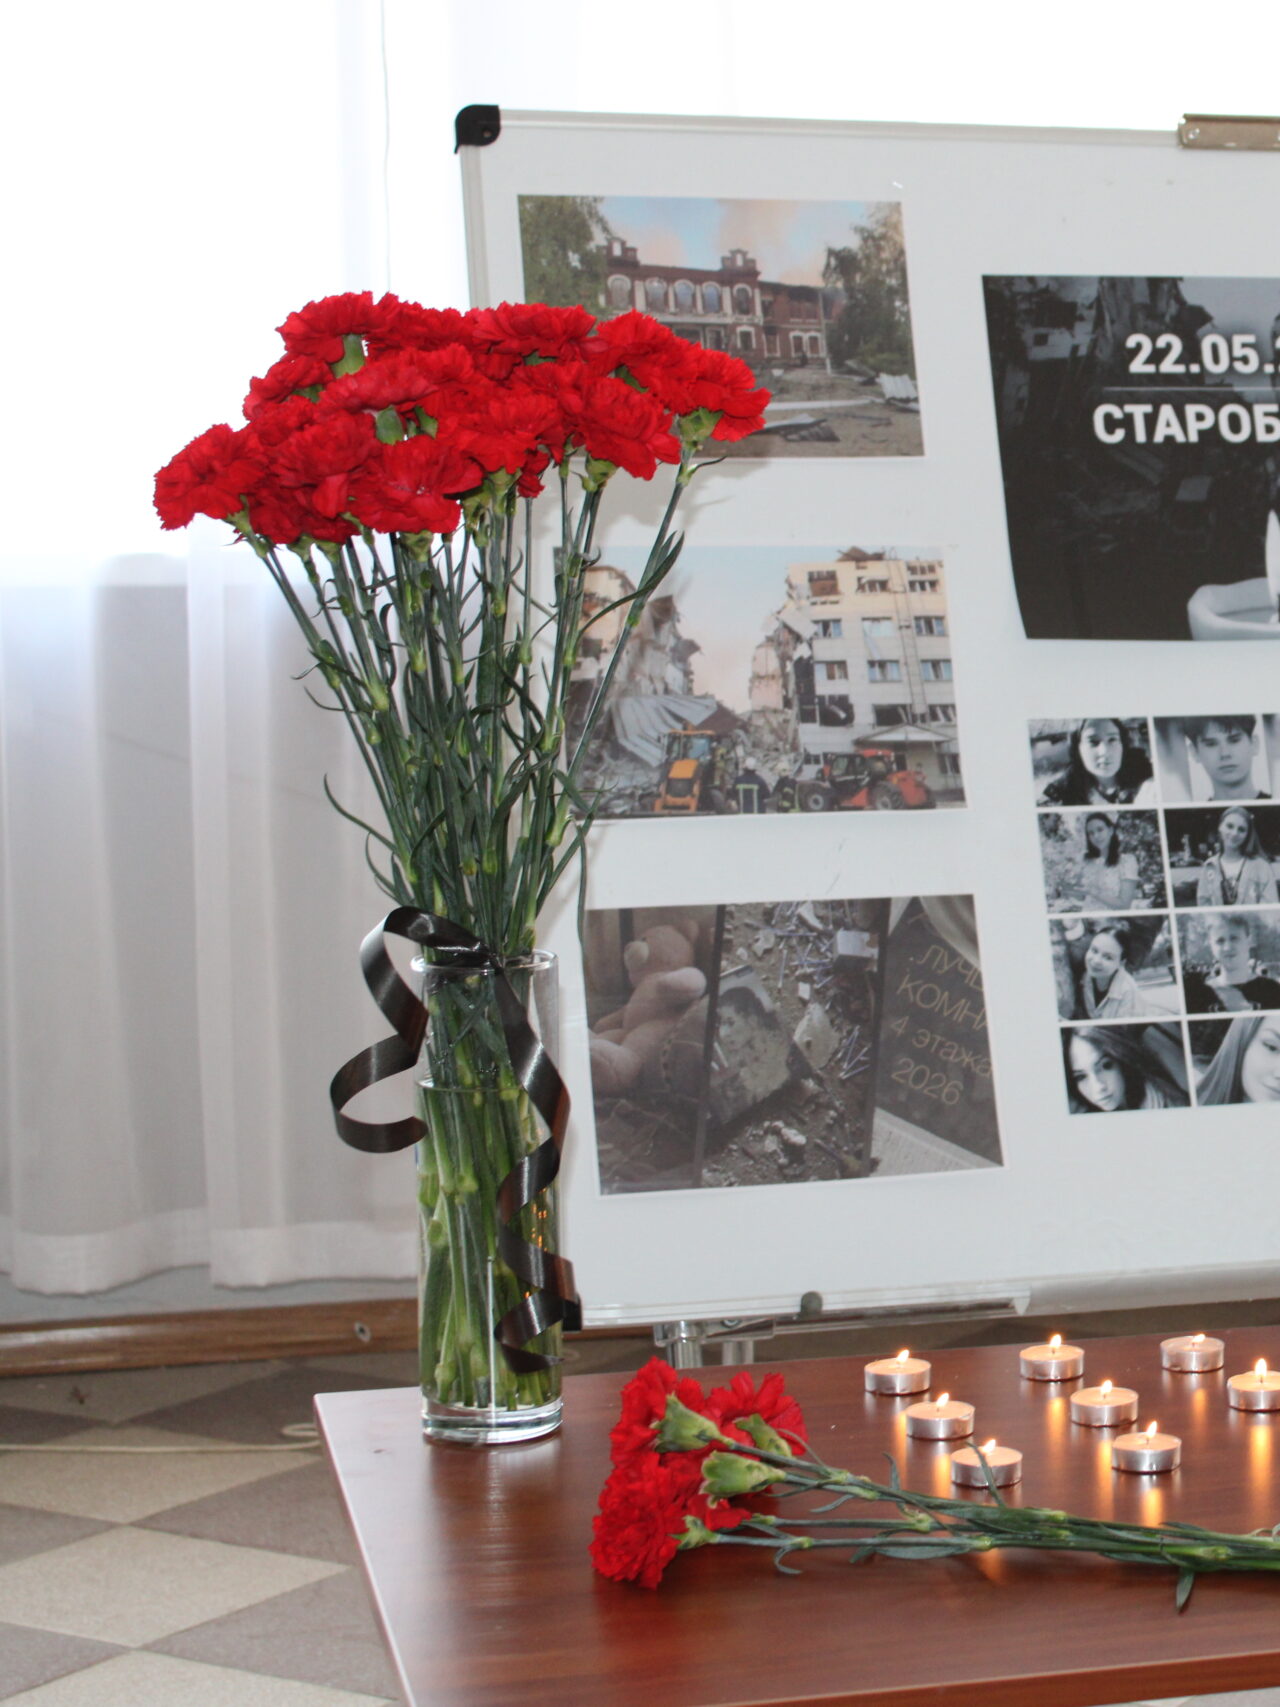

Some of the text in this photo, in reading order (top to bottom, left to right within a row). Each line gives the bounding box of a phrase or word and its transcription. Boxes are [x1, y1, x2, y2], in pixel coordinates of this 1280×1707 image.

[890, 1016, 992, 1078] 4 этажа
[890, 1057, 964, 1105] 2026
